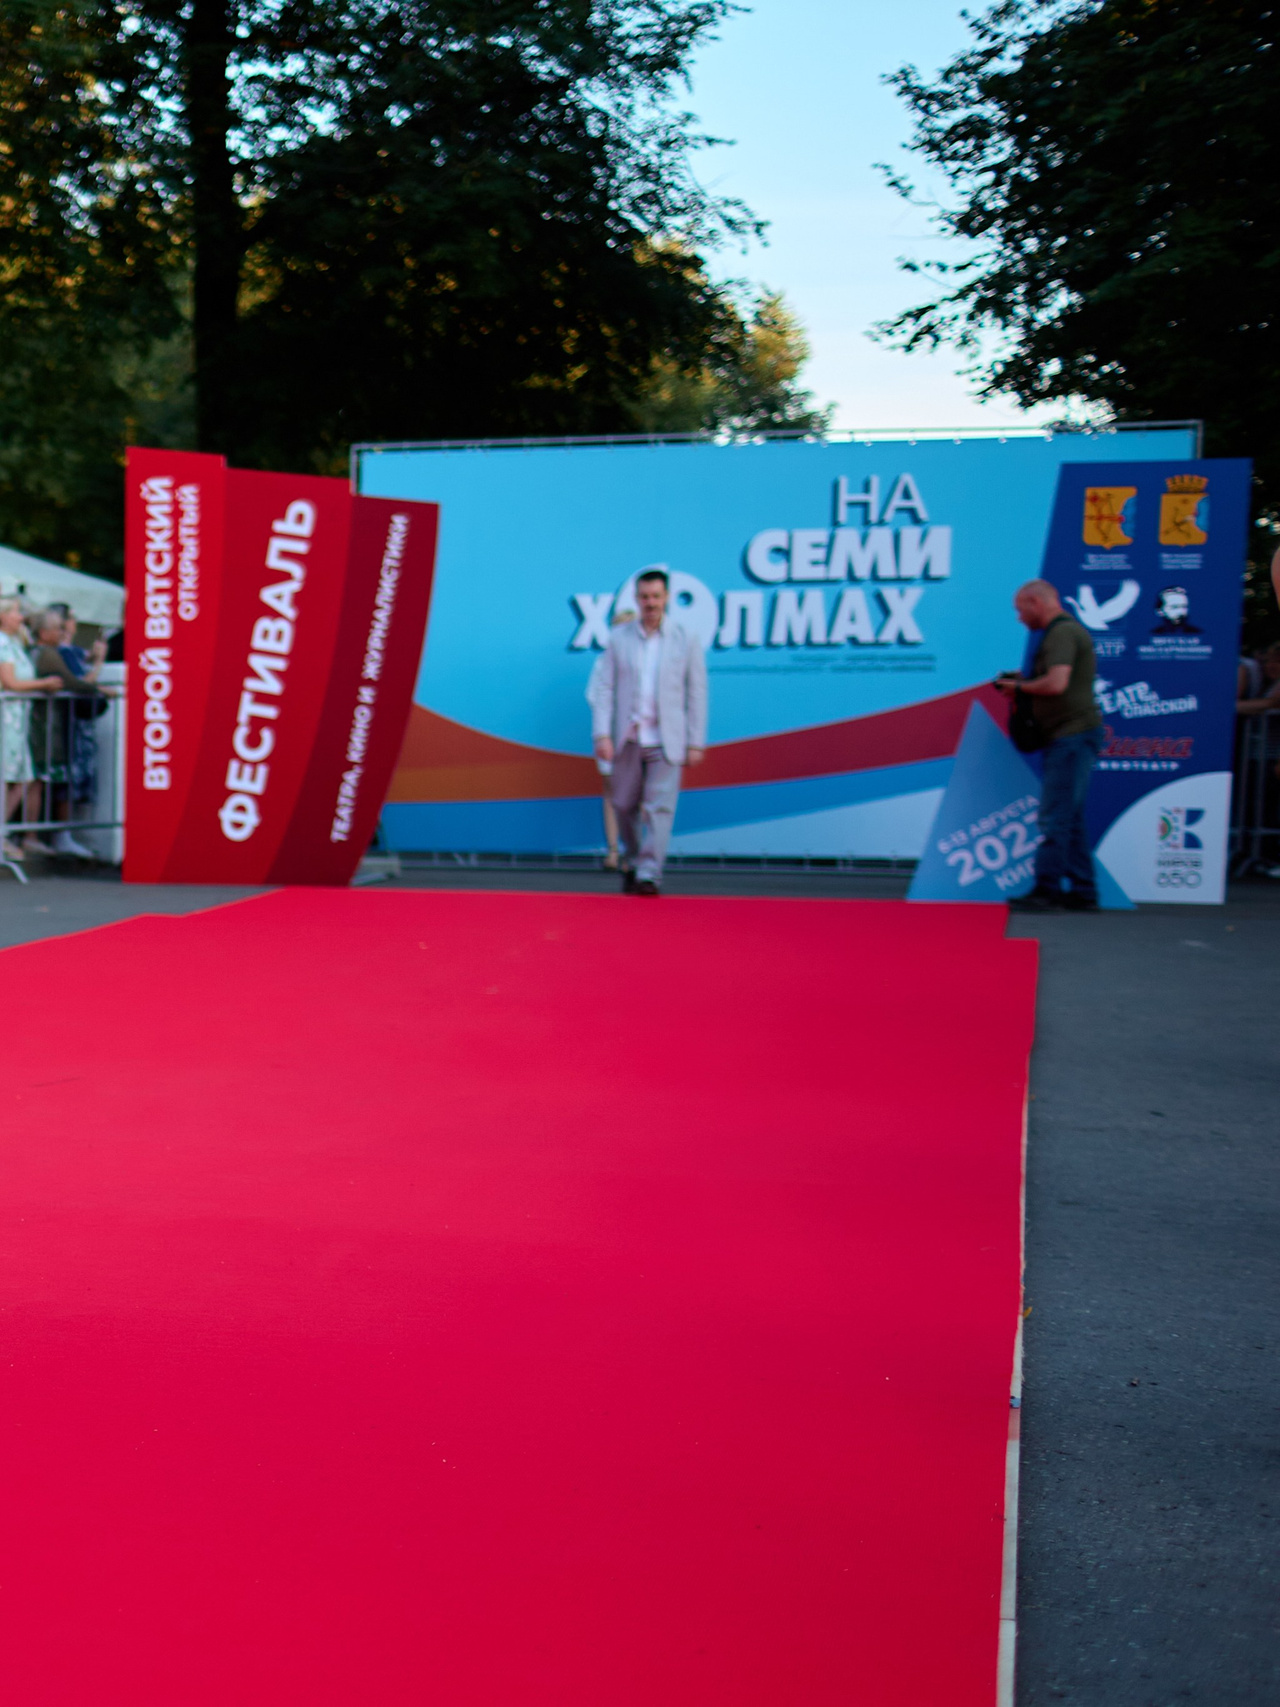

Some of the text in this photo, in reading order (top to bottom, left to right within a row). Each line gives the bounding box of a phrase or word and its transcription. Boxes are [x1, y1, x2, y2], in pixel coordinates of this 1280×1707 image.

[833, 472, 929, 525] НА
[176, 483, 200, 622] ОТКРЫТЫЙ
[361, 513, 410, 682] ЖУРНАЛИСТИКИ
[742, 526, 952, 584] СЕМИ
[139, 476, 175, 791] ВТОРОЙ ВЯТСКИЙ
[218, 498, 317, 842] ФЕСТИВАЛЬ
[345, 704, 374, 763] КИНО
[357, 686, 377, 704] И
